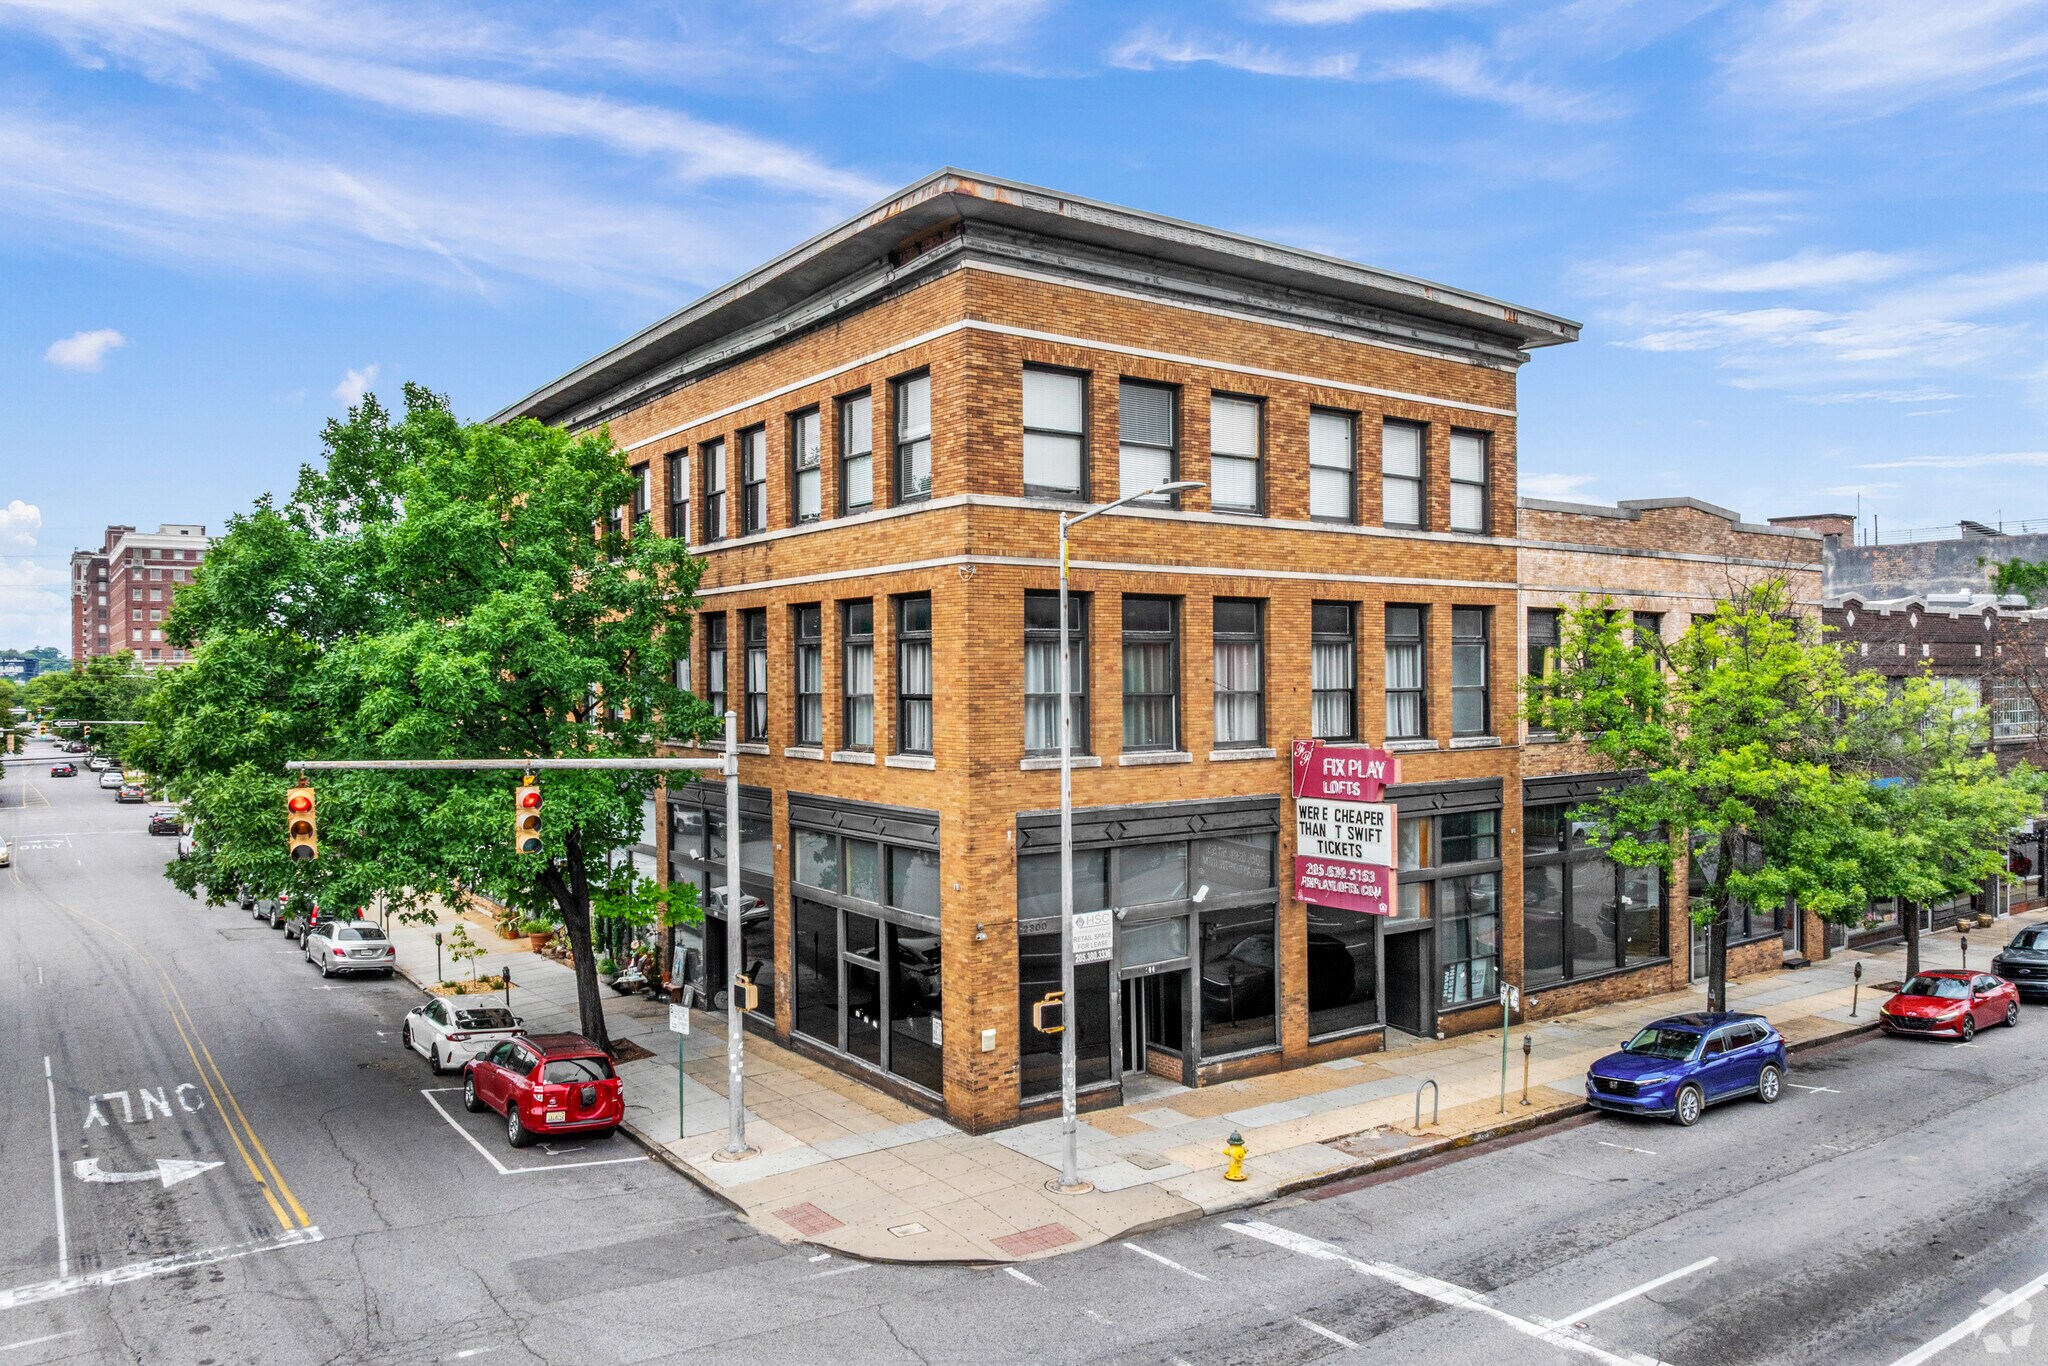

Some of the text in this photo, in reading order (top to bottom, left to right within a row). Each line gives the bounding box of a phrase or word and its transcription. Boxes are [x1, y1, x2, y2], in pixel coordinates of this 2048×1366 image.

[1322, 757, 1386, 779] FIX PLAY
[1322, 780, 1361, 796] LOFTS
[1334, 808, 1384, 826] CHEAPER
[1299, 821, 1382, 843] THAN T SWIFT
[1317, 840, 1362, 858] TICKETS
[1086, 913, 1110, 925] HSC
[1023, 922, 1047, 934] 2300
[1073, 931, 1112, 943] RETAIL SPACE
[1077, 939, 1109, 950] FOR LEASE
[83, 1083, 205, 1129] ONLY
